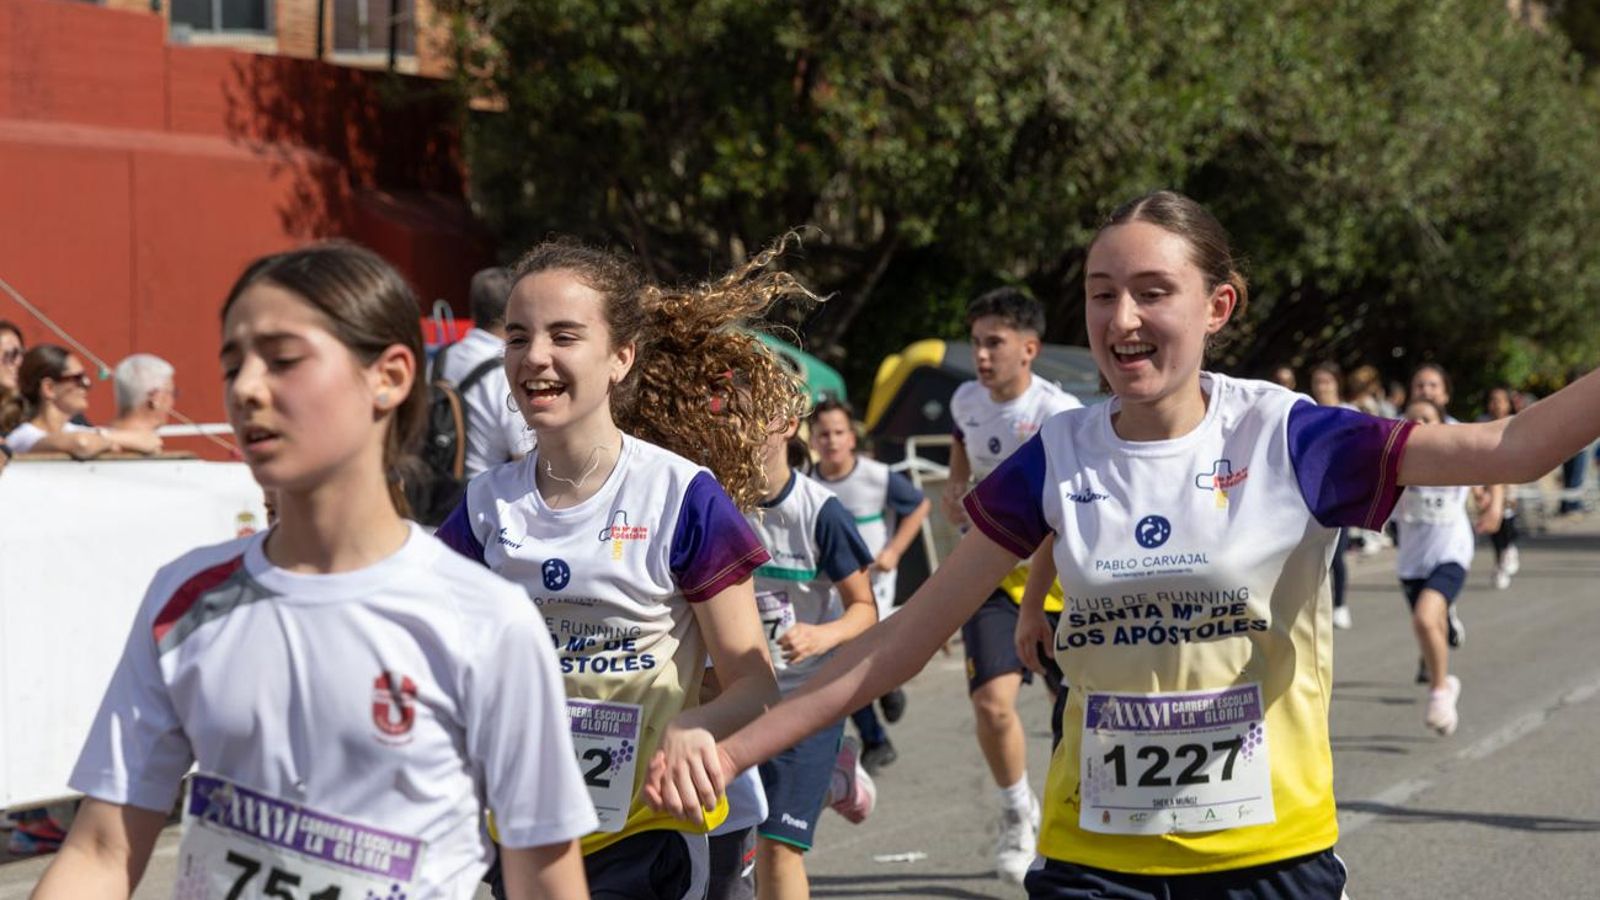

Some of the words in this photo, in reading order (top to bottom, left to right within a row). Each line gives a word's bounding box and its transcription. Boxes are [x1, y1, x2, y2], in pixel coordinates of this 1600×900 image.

[1095, 558, 1138, 572] PABLO
[1142, 553, 1209, 568] CARVAJAL
[1156, 586, 1249, 604] RUNNING
[1069, 603, 1164, 628] SANTA
[1172, 604, 1203, 621] Mª
[1210, 602, 1248, 617] DE
[560, 619, 641, 640] RUNNING
[1056, 628, 1105, 651] LOS
[1113, 617, 1268, 646] APÓSTOLES
[565, 635, 596, 653] Mª
[603, 637, 638, 652] DE
[560, 654, 656, 674] STOLES
[594, 709, 634, 723] ESCOLAR
[1114, 701, 1171, 727] XXXVI
[1171, 698, 1214, 713] CARRERA
[1216, 691, 1254, 709] ESCOLAR
[1181, 712, 1196, 726] LA
[1204, 707, 1245, 723] GLORIA
[580, 719, 620, 734] GLORIA
[1103, 738, 1244, 787] 1227
[299, 814, 355, 845] CARRERA
[355, 829, 412, 861] ESCOLAR
[303, 831, 325, 854] LA
[332, 843, 391, 871] GLORIA
[224, 849, 342, 900] 75
